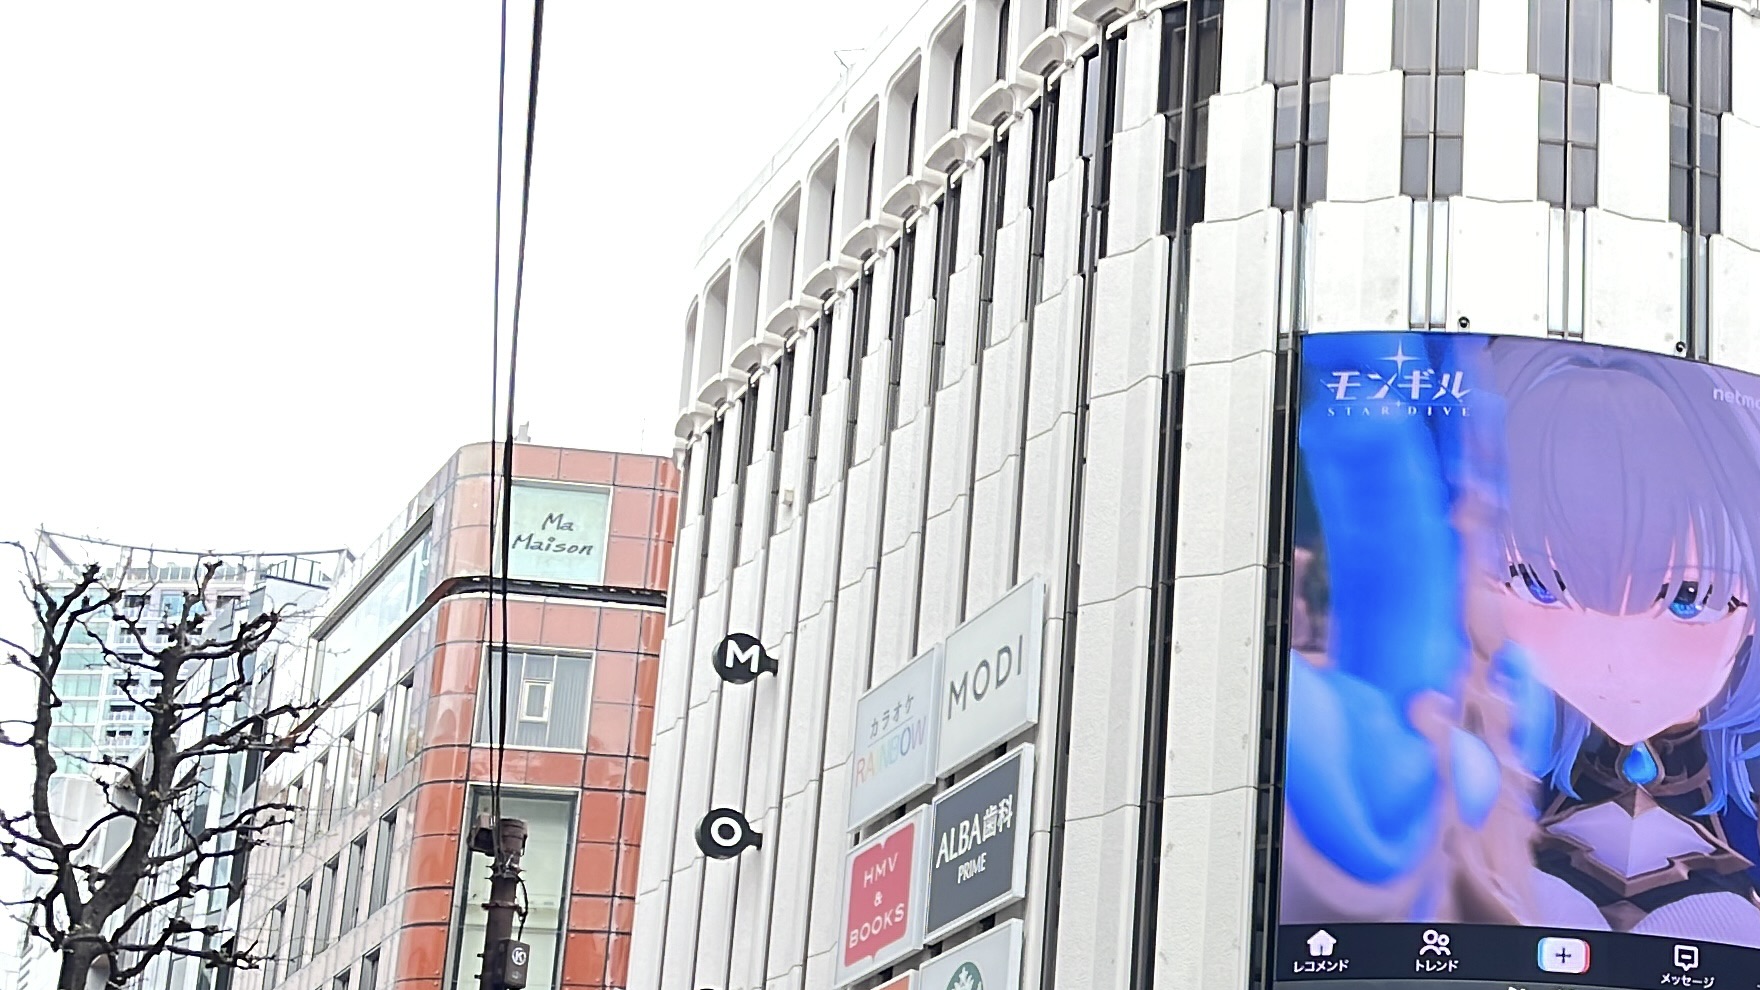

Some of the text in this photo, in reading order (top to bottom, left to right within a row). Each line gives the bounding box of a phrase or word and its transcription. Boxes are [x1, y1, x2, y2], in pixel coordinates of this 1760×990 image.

[1327, 369, 1472, 401] モンギル
[1327, 406, 1472, 418] STAR DIVE
[541, 511, 574, 532] Ma
[511, 532, 594, 558] Maison
[948, 634, 1024, 721] MODI
[869, 694, 915, 740] カラオケ
[855, 714, 927, 788] RAINBOW
[935, 794, 1014, 869] ALBA歯科
[863, 851, 899, 888] HMV
[957, 852, 987, 884] PRIME
[873, 891, 883, 907] &
[848, 902, 905, 949] BOOKS
[1293, 957, 1350, 973] レコメンド
[1414, 958, 1460, 973] トレンド
[1660, 972, 1716, 990] メッセージ
